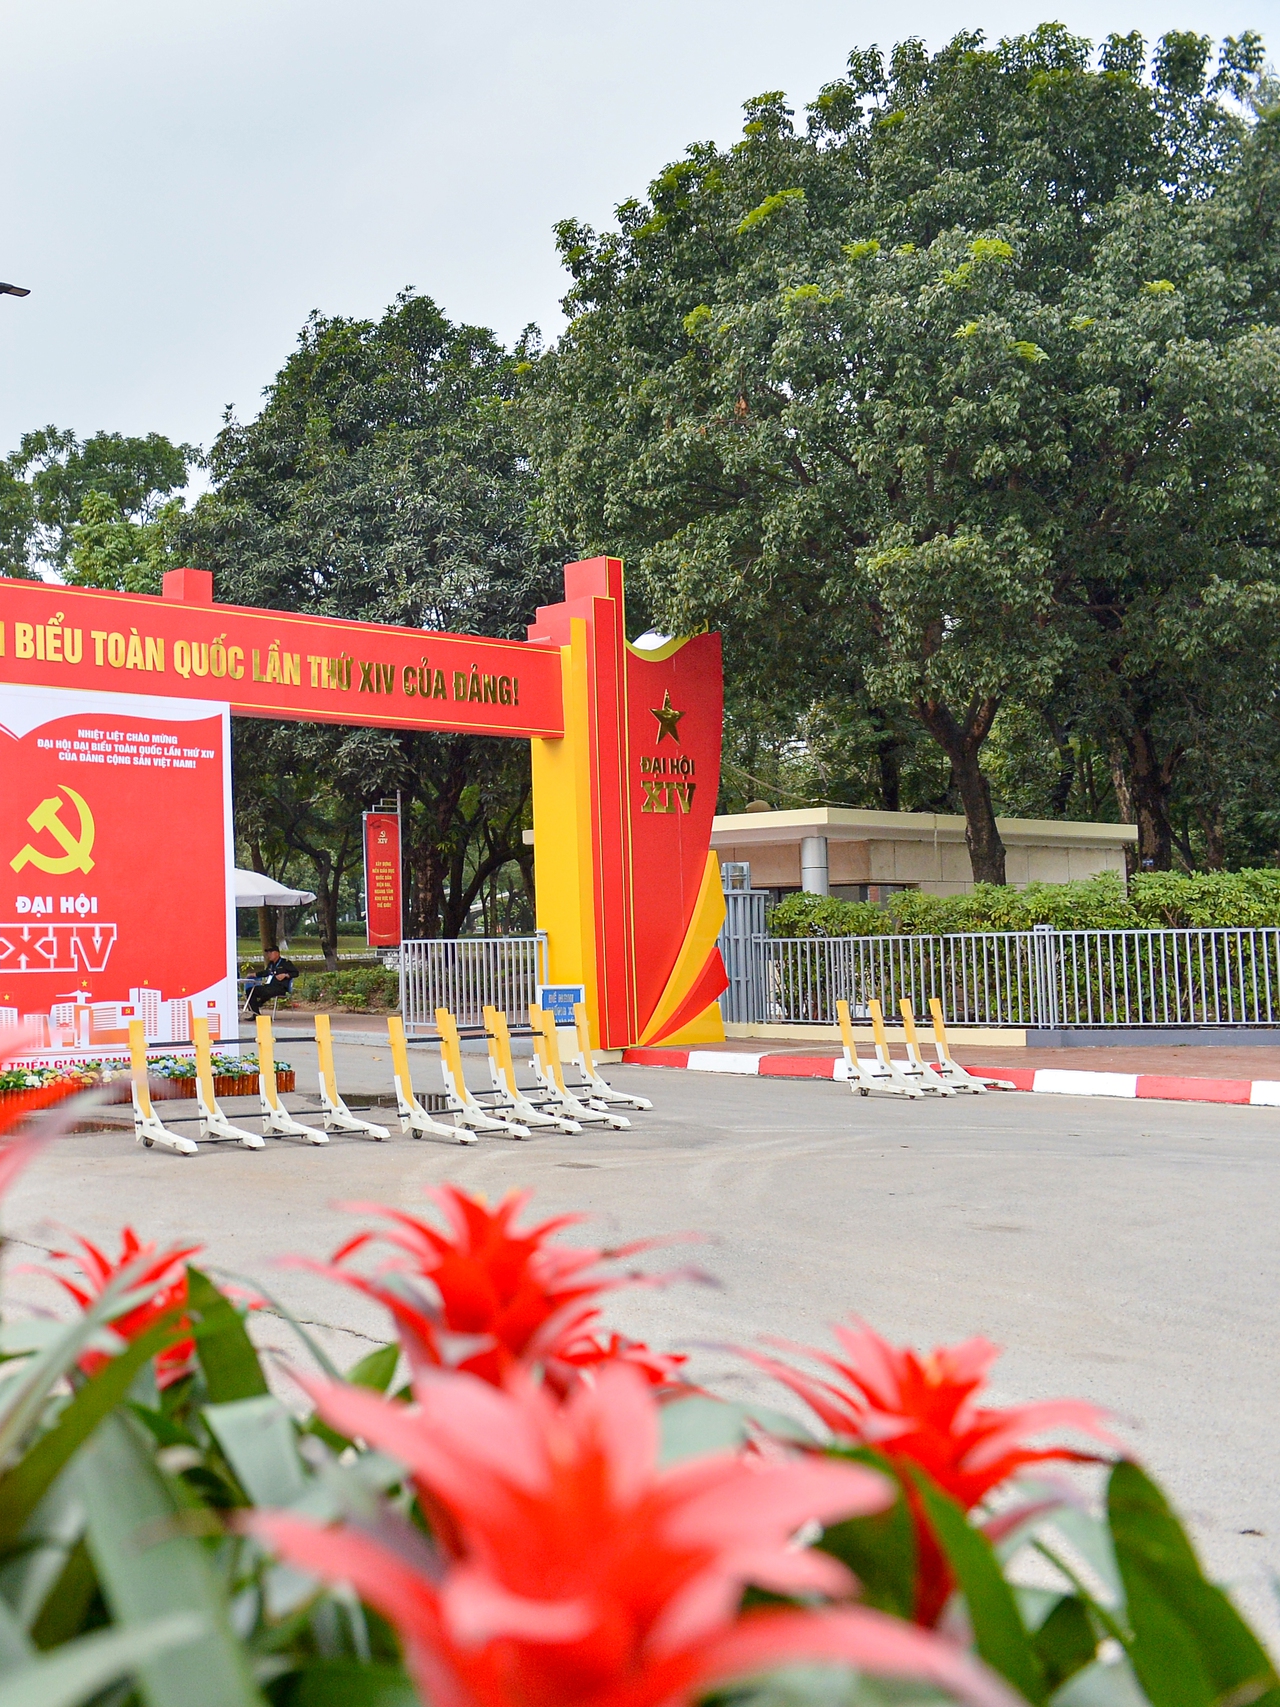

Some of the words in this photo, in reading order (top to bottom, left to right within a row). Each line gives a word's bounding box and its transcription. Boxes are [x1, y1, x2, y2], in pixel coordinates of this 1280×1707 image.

[15, 612, 82, 664] BIỂU
[91, 628, 165, 672] TOÀN
[173, 634, 245, 680] QUỐC
[252, 639, 300, 686] LẦN
[307, 652, 354, 691] THỨ
[358, 661, 395, 695] XIV
[403, 656, 447, 700] CỦA
[453, 664, 519, 706] ĐẢNG!
[37, 739, 53, 750] ĐẠI
[56, 739, 71, 751] HỘI
[74, 741, 89, 752] ĐẠI
[91, 741, 112, 752] BIỂU
[114, 743, 137, 754] TOÀN
[139, 744, 162, 756] QUỐC
[164, 746, 181, 757] LẦN
[183, 747, 200, 758] THỨ
[201, 750, 214, 759] XIV
[78, 729, 104, 740] NHIỆT
[106, 730, 124, 742] LIỆT
[126, 731, 149, 743] CHÀO
[152, 732, 178, 744] MỪNG
[58, 750, 77, 761] CỦA
[79, 751, 104, 763] ĐẢNG
[106, 755, 130, 765] CỘNG
[133, 754, 151, 766] SẢN
[153, 757, 170, 768] VIỆT
[173, 759, 196, 768] NAM!
[640, 756, 666, 779] ĐẠI
[669, 755, 695, 780] HỘI
[641, 780, 696, 814] XIV
[16, 896, 53, 917] ĐẠI
[60, 893, 98, 918] HỘI
